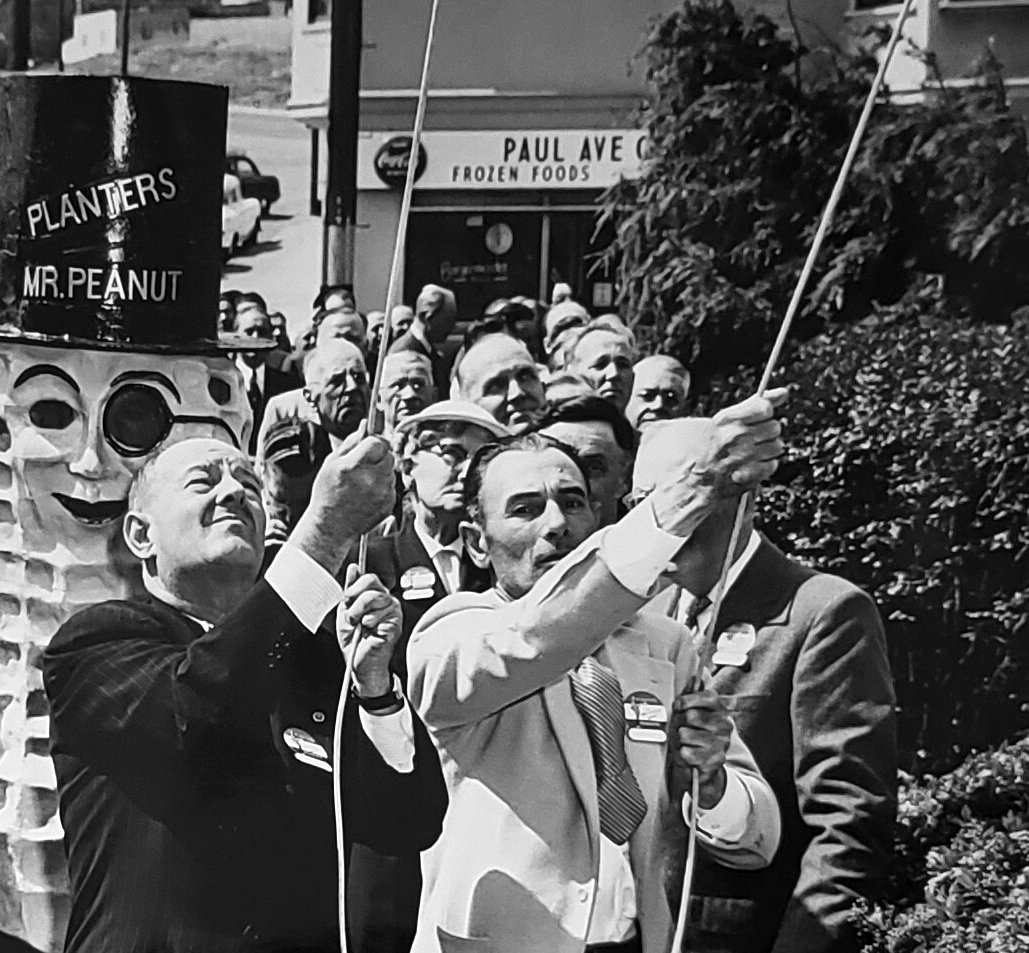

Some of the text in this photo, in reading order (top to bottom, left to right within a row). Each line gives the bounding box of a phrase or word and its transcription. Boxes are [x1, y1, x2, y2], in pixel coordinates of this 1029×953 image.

[504, 137, 565, 162] PAUL
[579, 136, 623, 162] AVE
[453, 165, 589, 182] FROZEN FOODS
[27, 167, 175, 237] PLANTERS
